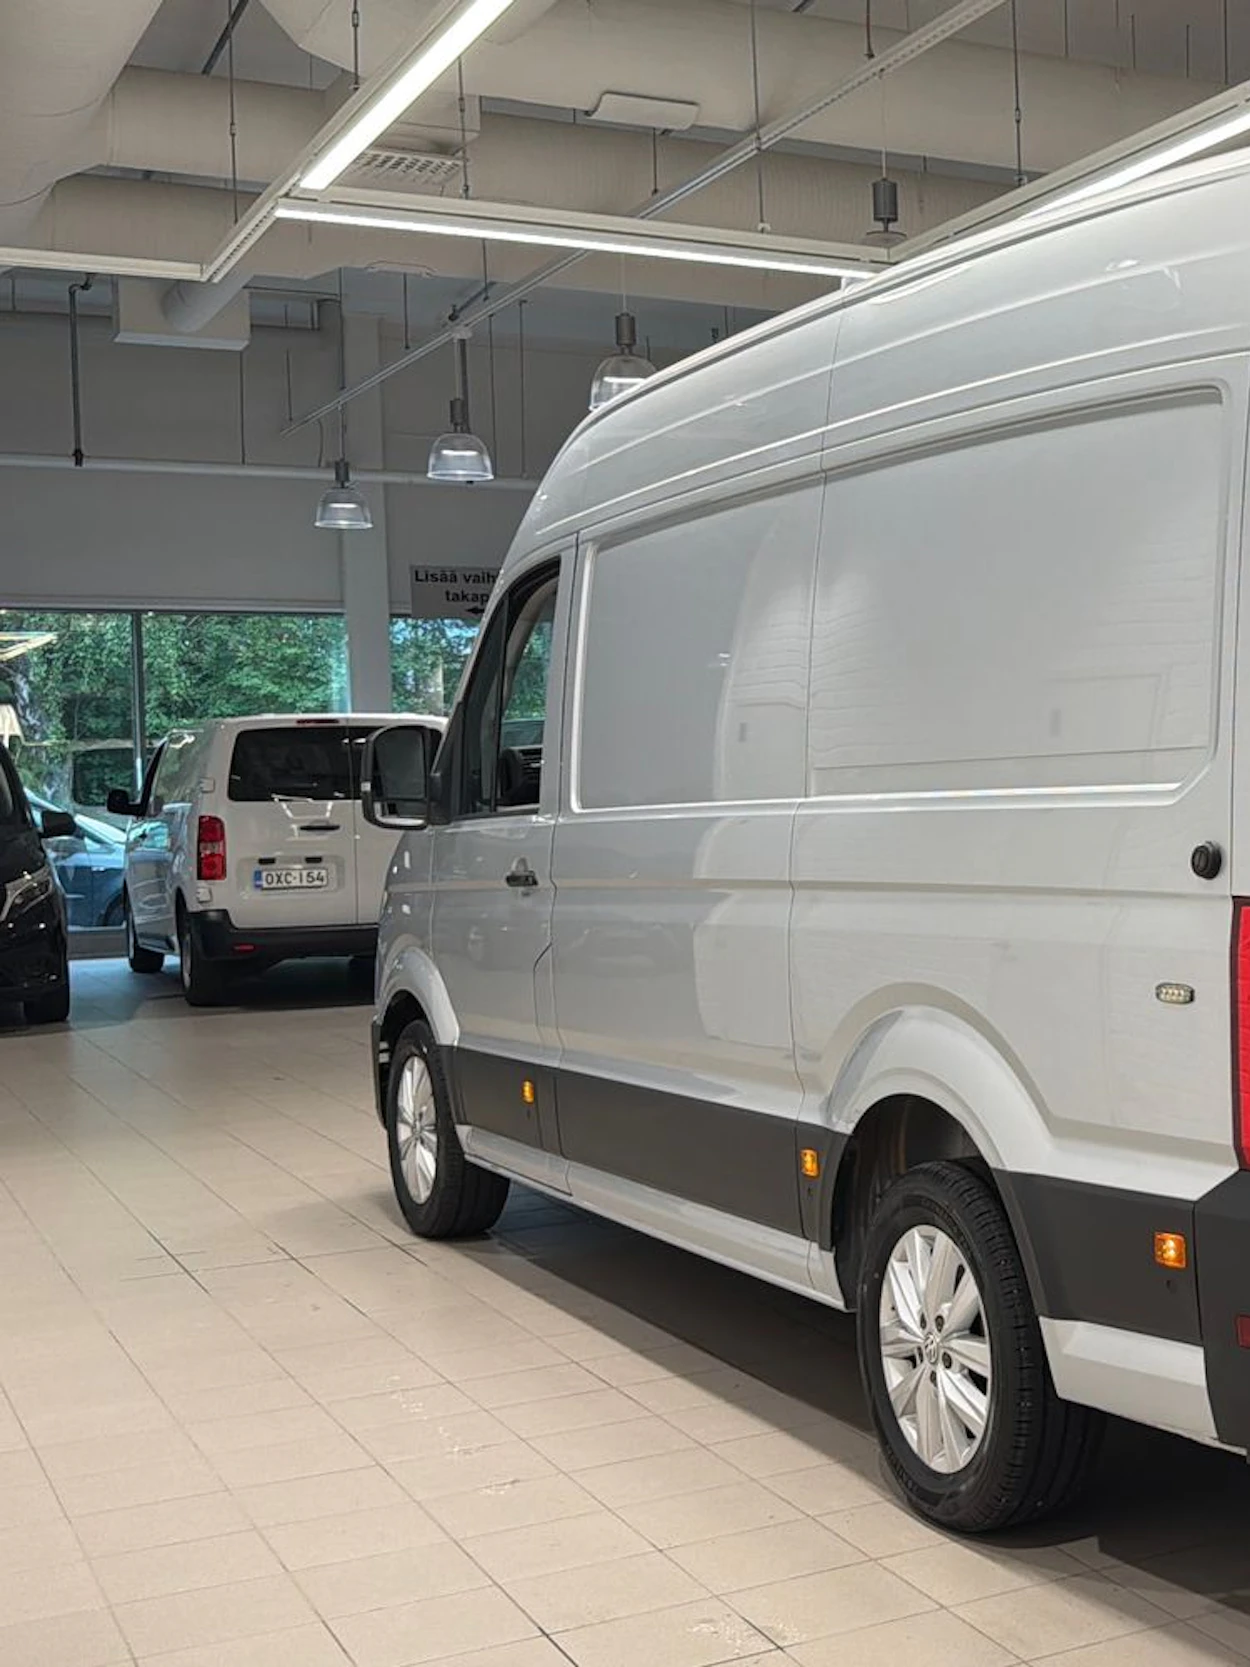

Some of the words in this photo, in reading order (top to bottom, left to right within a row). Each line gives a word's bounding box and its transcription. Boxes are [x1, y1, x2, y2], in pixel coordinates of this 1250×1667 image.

[414, 569, 457, 583] Lisää
[463, 571, 500, 584] vaih
[264, 870, 325, 886] OXC-154
